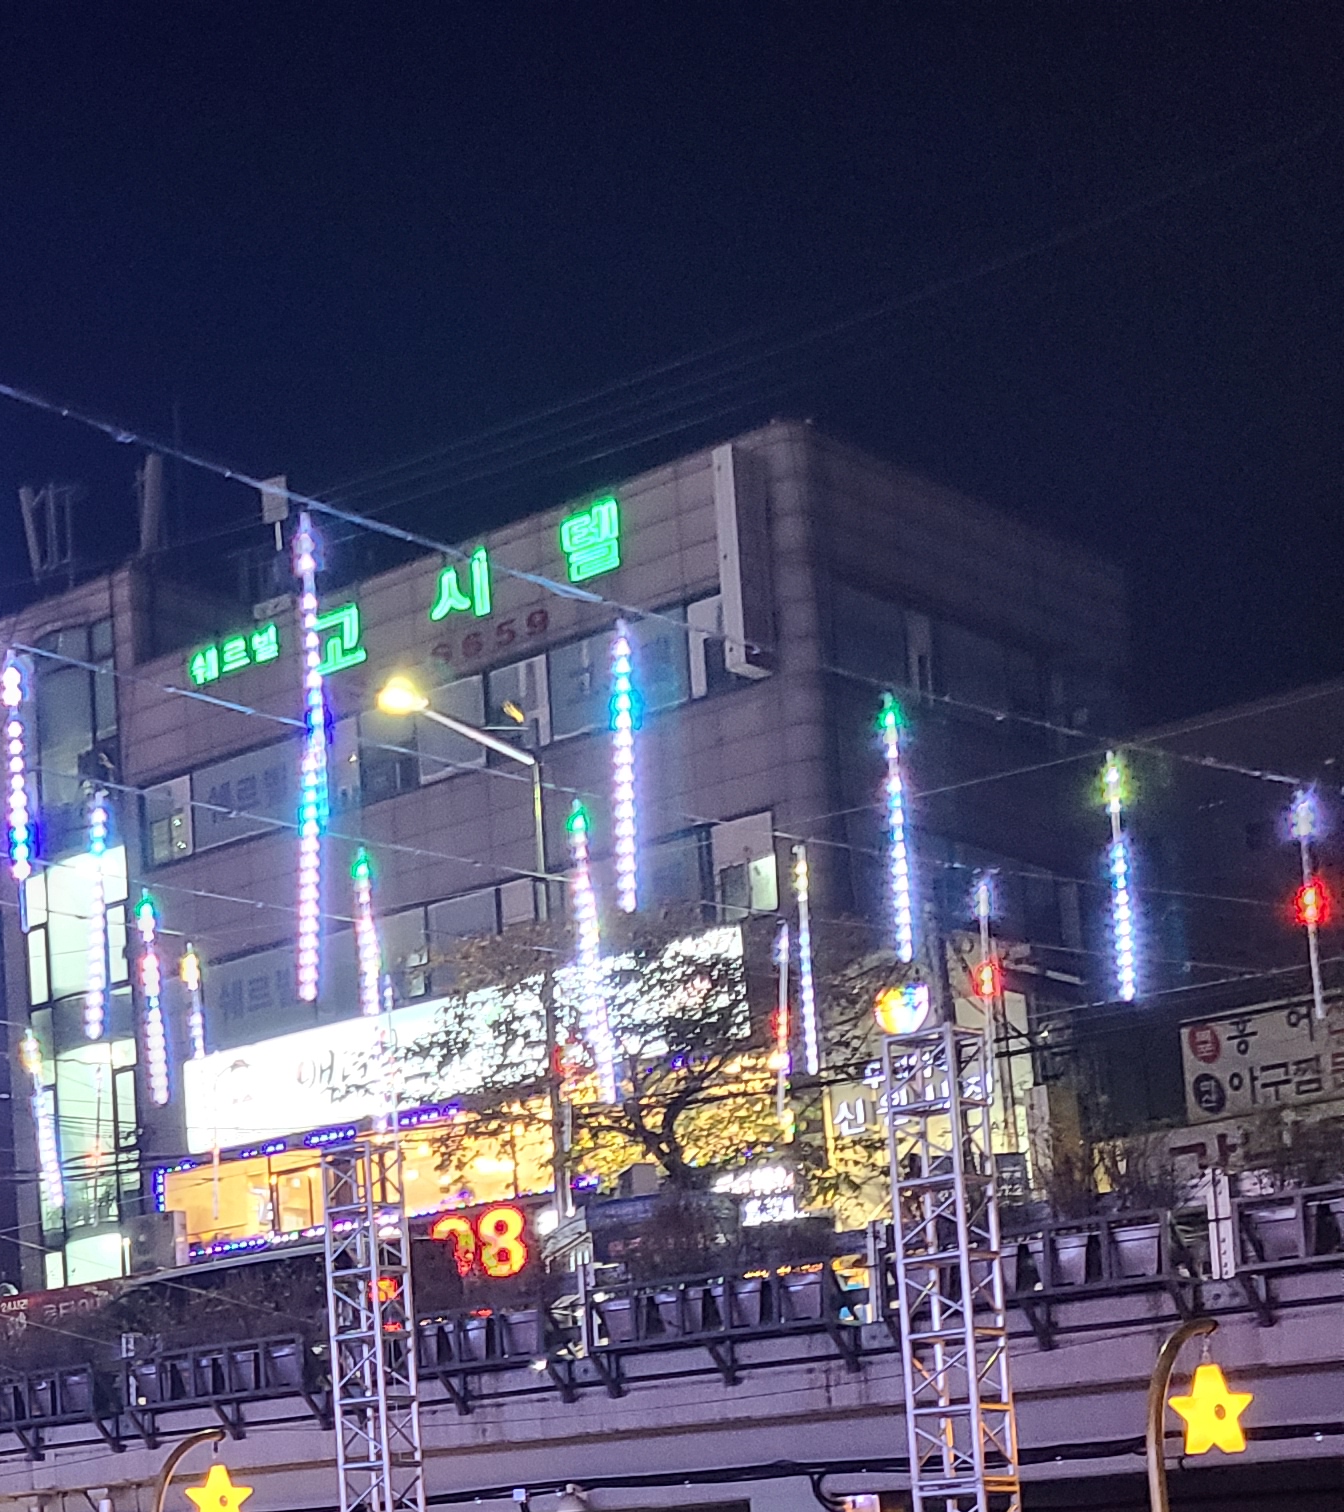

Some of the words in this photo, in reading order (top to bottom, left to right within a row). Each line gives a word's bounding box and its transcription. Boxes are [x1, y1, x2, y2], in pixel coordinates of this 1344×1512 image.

[190, 623, 280, 686] 쉐르빌
[309, 497, 622, 677] 고시텔
[1226, 1004, 1315, 1056] 홍어
[1228, 1053, 1324, 1104] 아구찜
